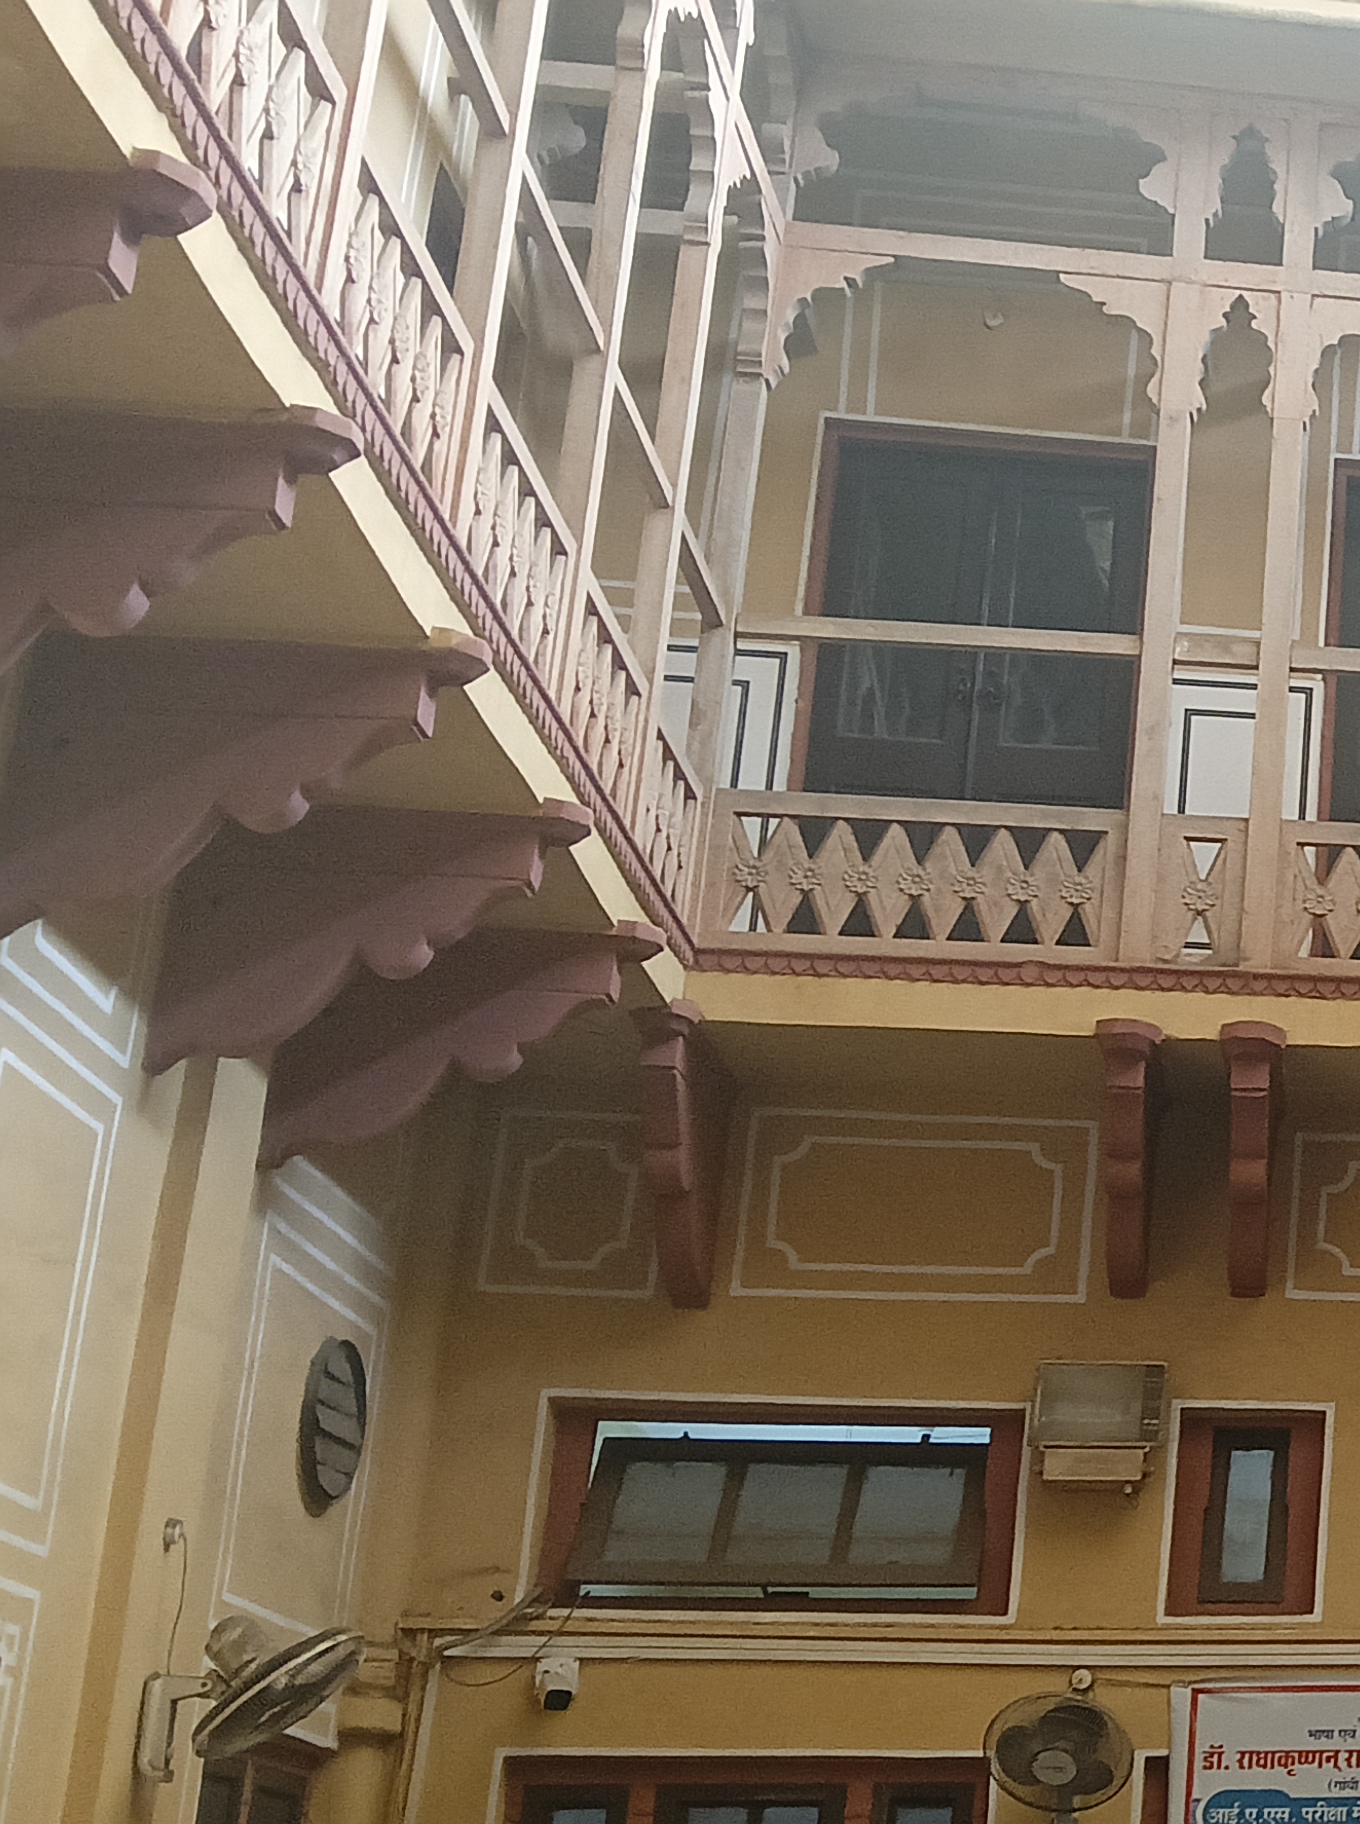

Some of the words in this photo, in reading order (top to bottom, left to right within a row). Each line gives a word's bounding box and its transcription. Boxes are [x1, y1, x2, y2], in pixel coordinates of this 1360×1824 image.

[1202, 1744, 1230, 1770] डॉ.
[1235, 1750, 1342, 1776] राधाकृष्णन्
[1302, 1801, 1349, 1822] परीक्षा
